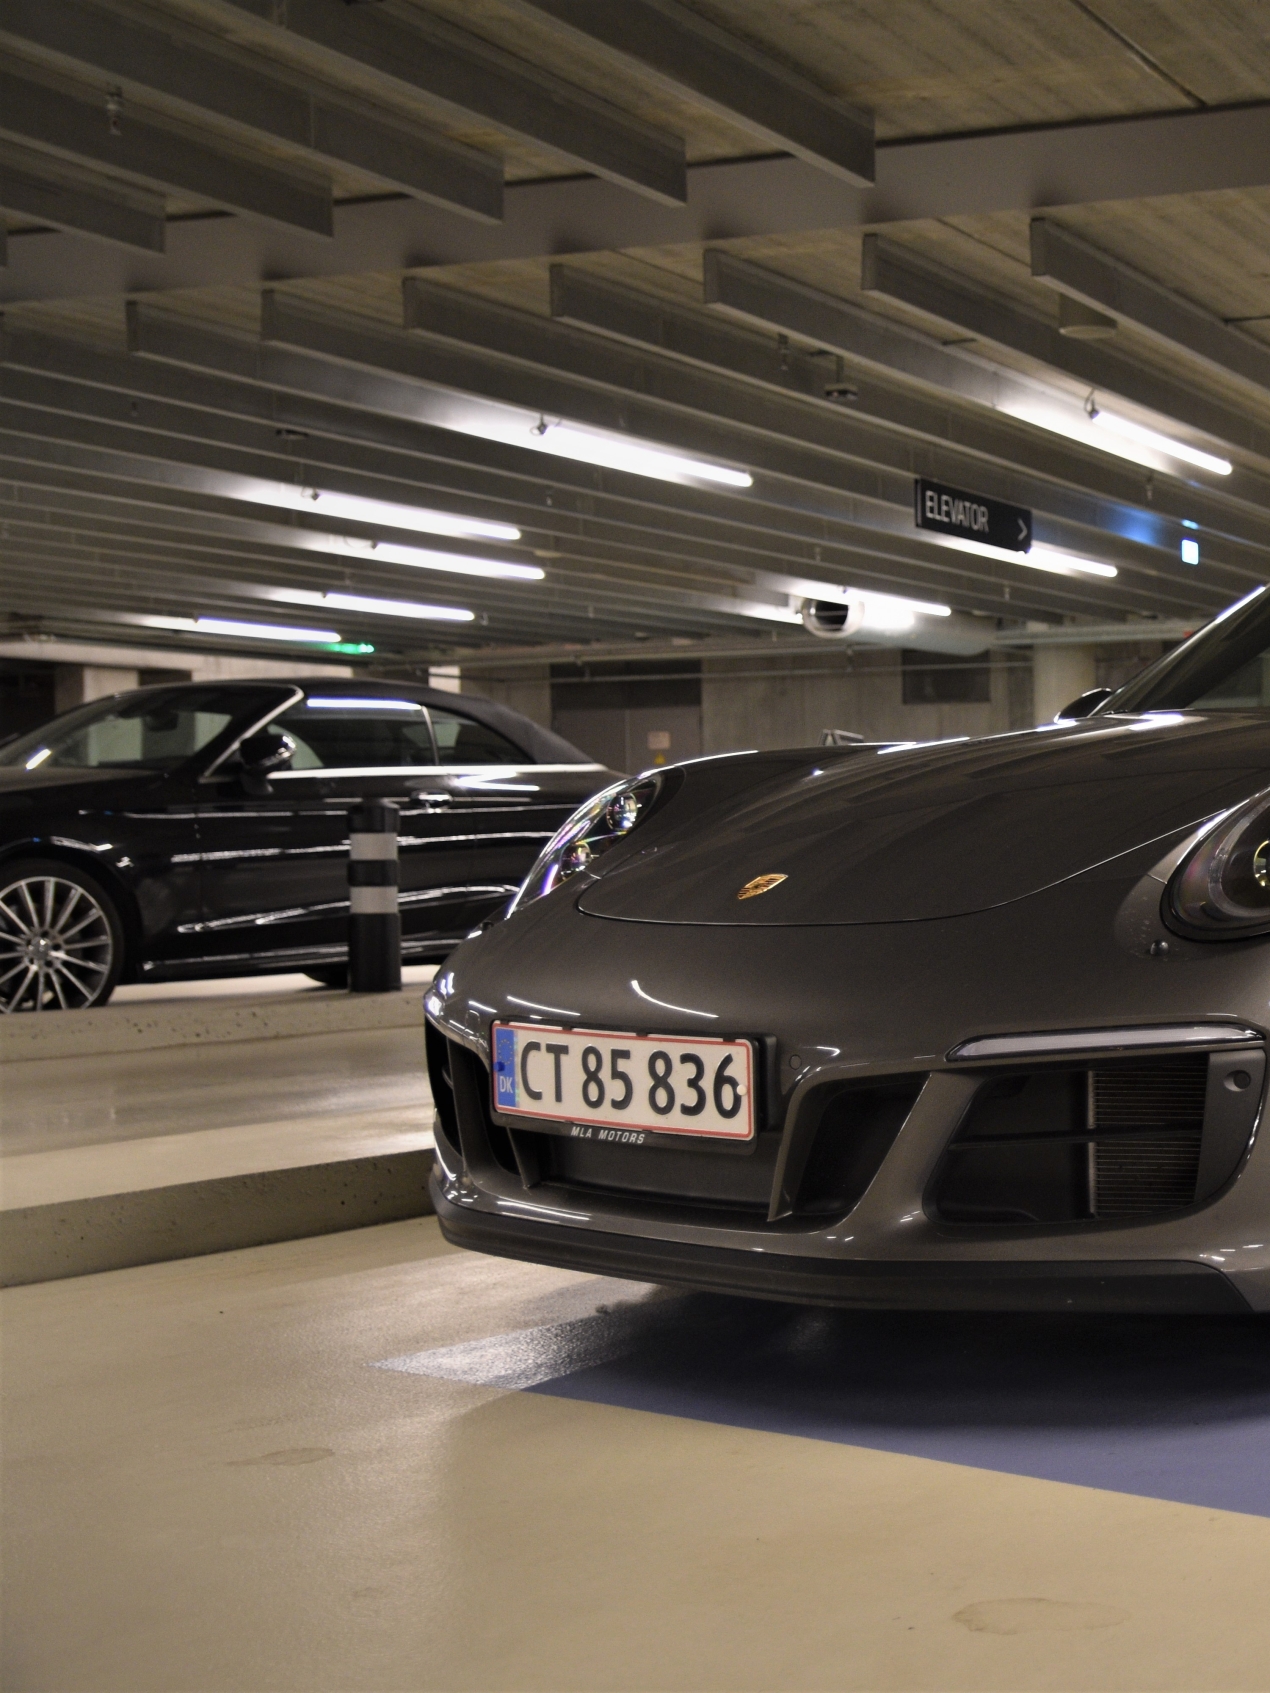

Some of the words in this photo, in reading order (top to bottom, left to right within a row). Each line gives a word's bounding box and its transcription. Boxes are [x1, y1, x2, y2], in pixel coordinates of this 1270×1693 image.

[925, 490, 989, 533] ELEVATOR
[500, 1075, 513, 1094] DK
[520, 1040, 569, 1103] CT
[581, 1044, 633, 1110] 85
[648, 1049, 742, 1120] 836
[570, 1125, 593, 1139] MLA
[598, 1130, 645, 1144] MOTORS
